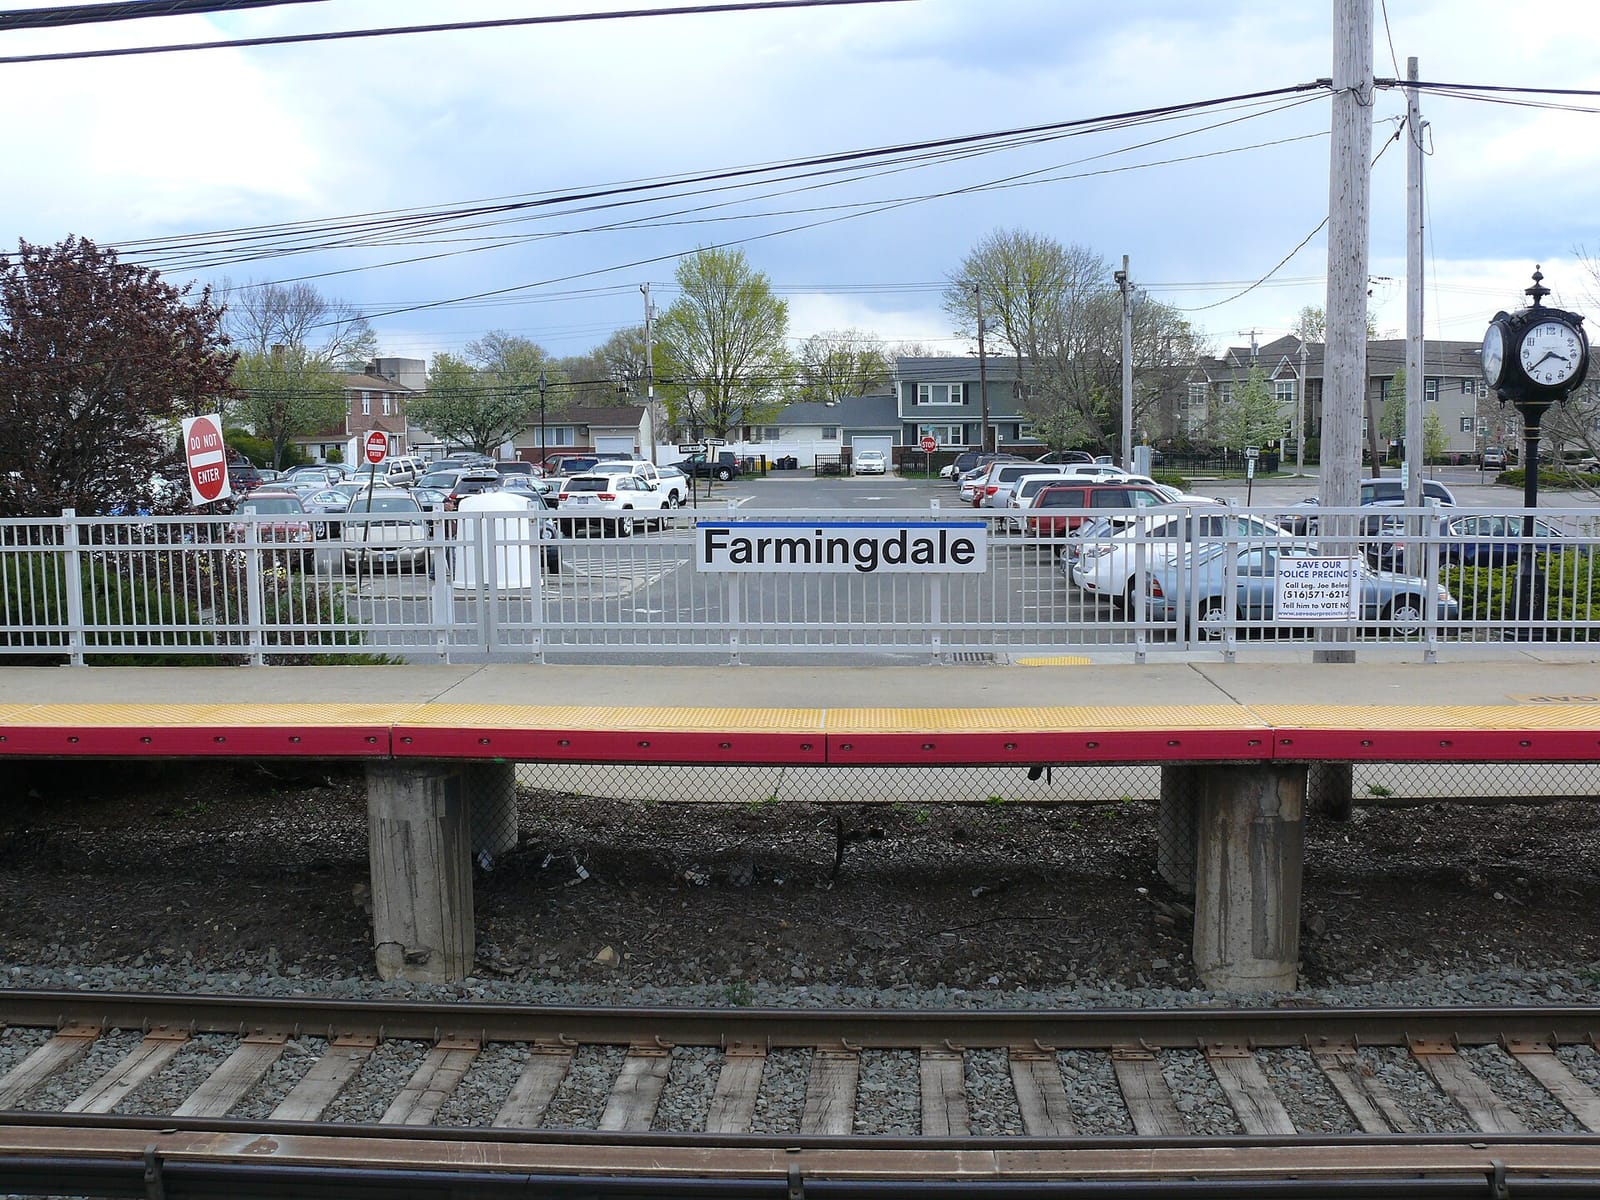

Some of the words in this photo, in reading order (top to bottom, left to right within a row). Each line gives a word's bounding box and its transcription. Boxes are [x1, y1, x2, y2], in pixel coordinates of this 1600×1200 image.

[1546, 326, 1556, 335] 12
[1567, 337, 1574, 347] 2
[1565, 361, 1572, 370] 4
[191, 436, 200, 450] DO
[203, 433, 217, 448] NOT
[198, 468, 220, 485] ENTER
[704, 529, 976, 572] Farmingdale
[1296, 561, 1319, 569] SAVE
[1321, 561, 1341, 569] OUR
[1279, 570, 1309, 579] POLICE
[1312, 569, 1358, 578] PRECINCS
